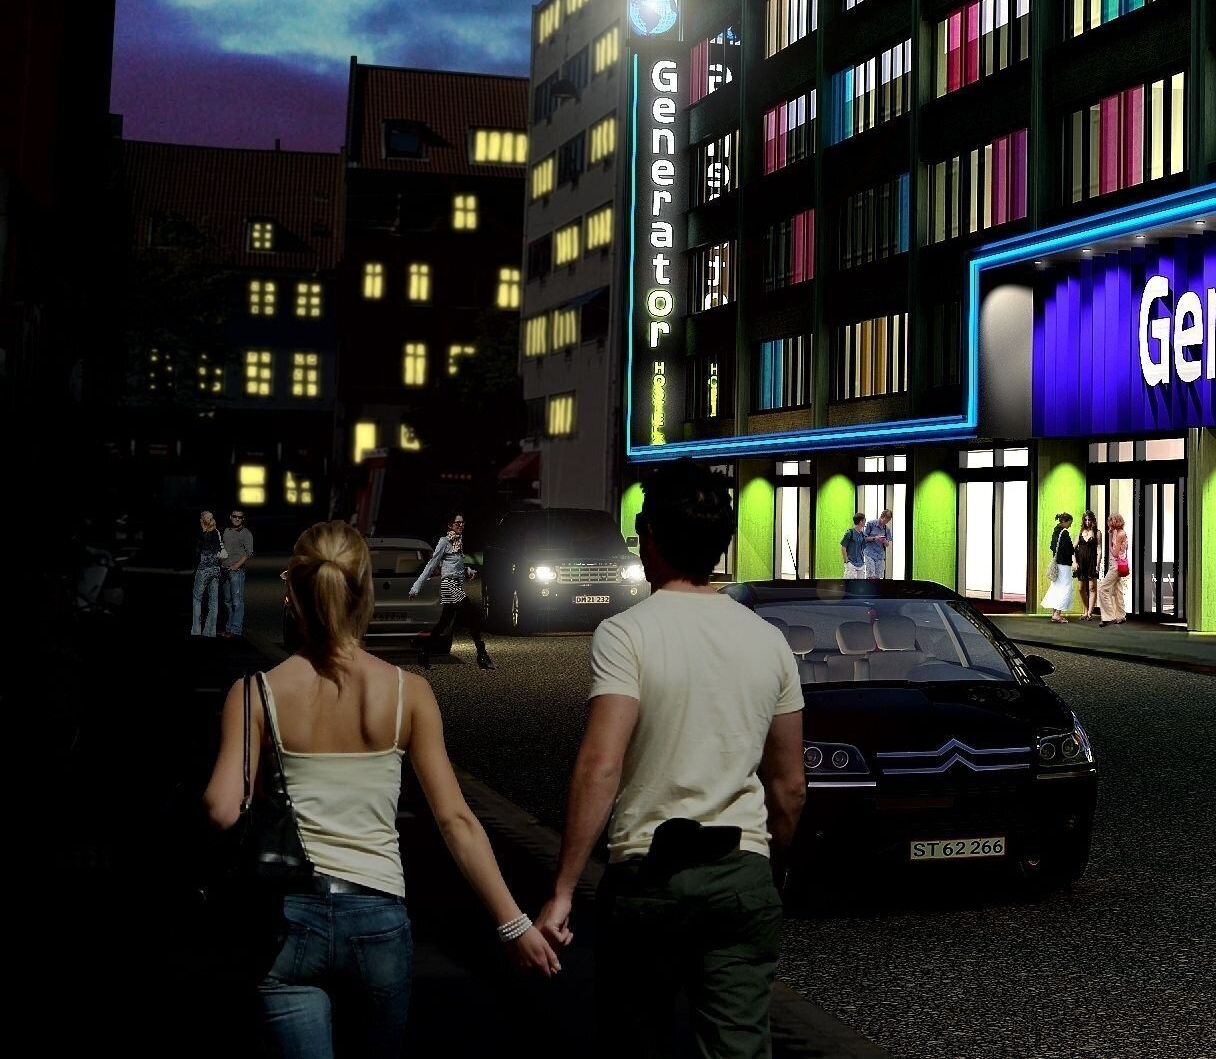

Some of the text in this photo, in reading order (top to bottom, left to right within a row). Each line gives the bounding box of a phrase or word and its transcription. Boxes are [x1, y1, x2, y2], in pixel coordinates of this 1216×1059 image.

[647, 60, 678, 348] Generator
[913, 839, 1004, 857] ST 62 266
